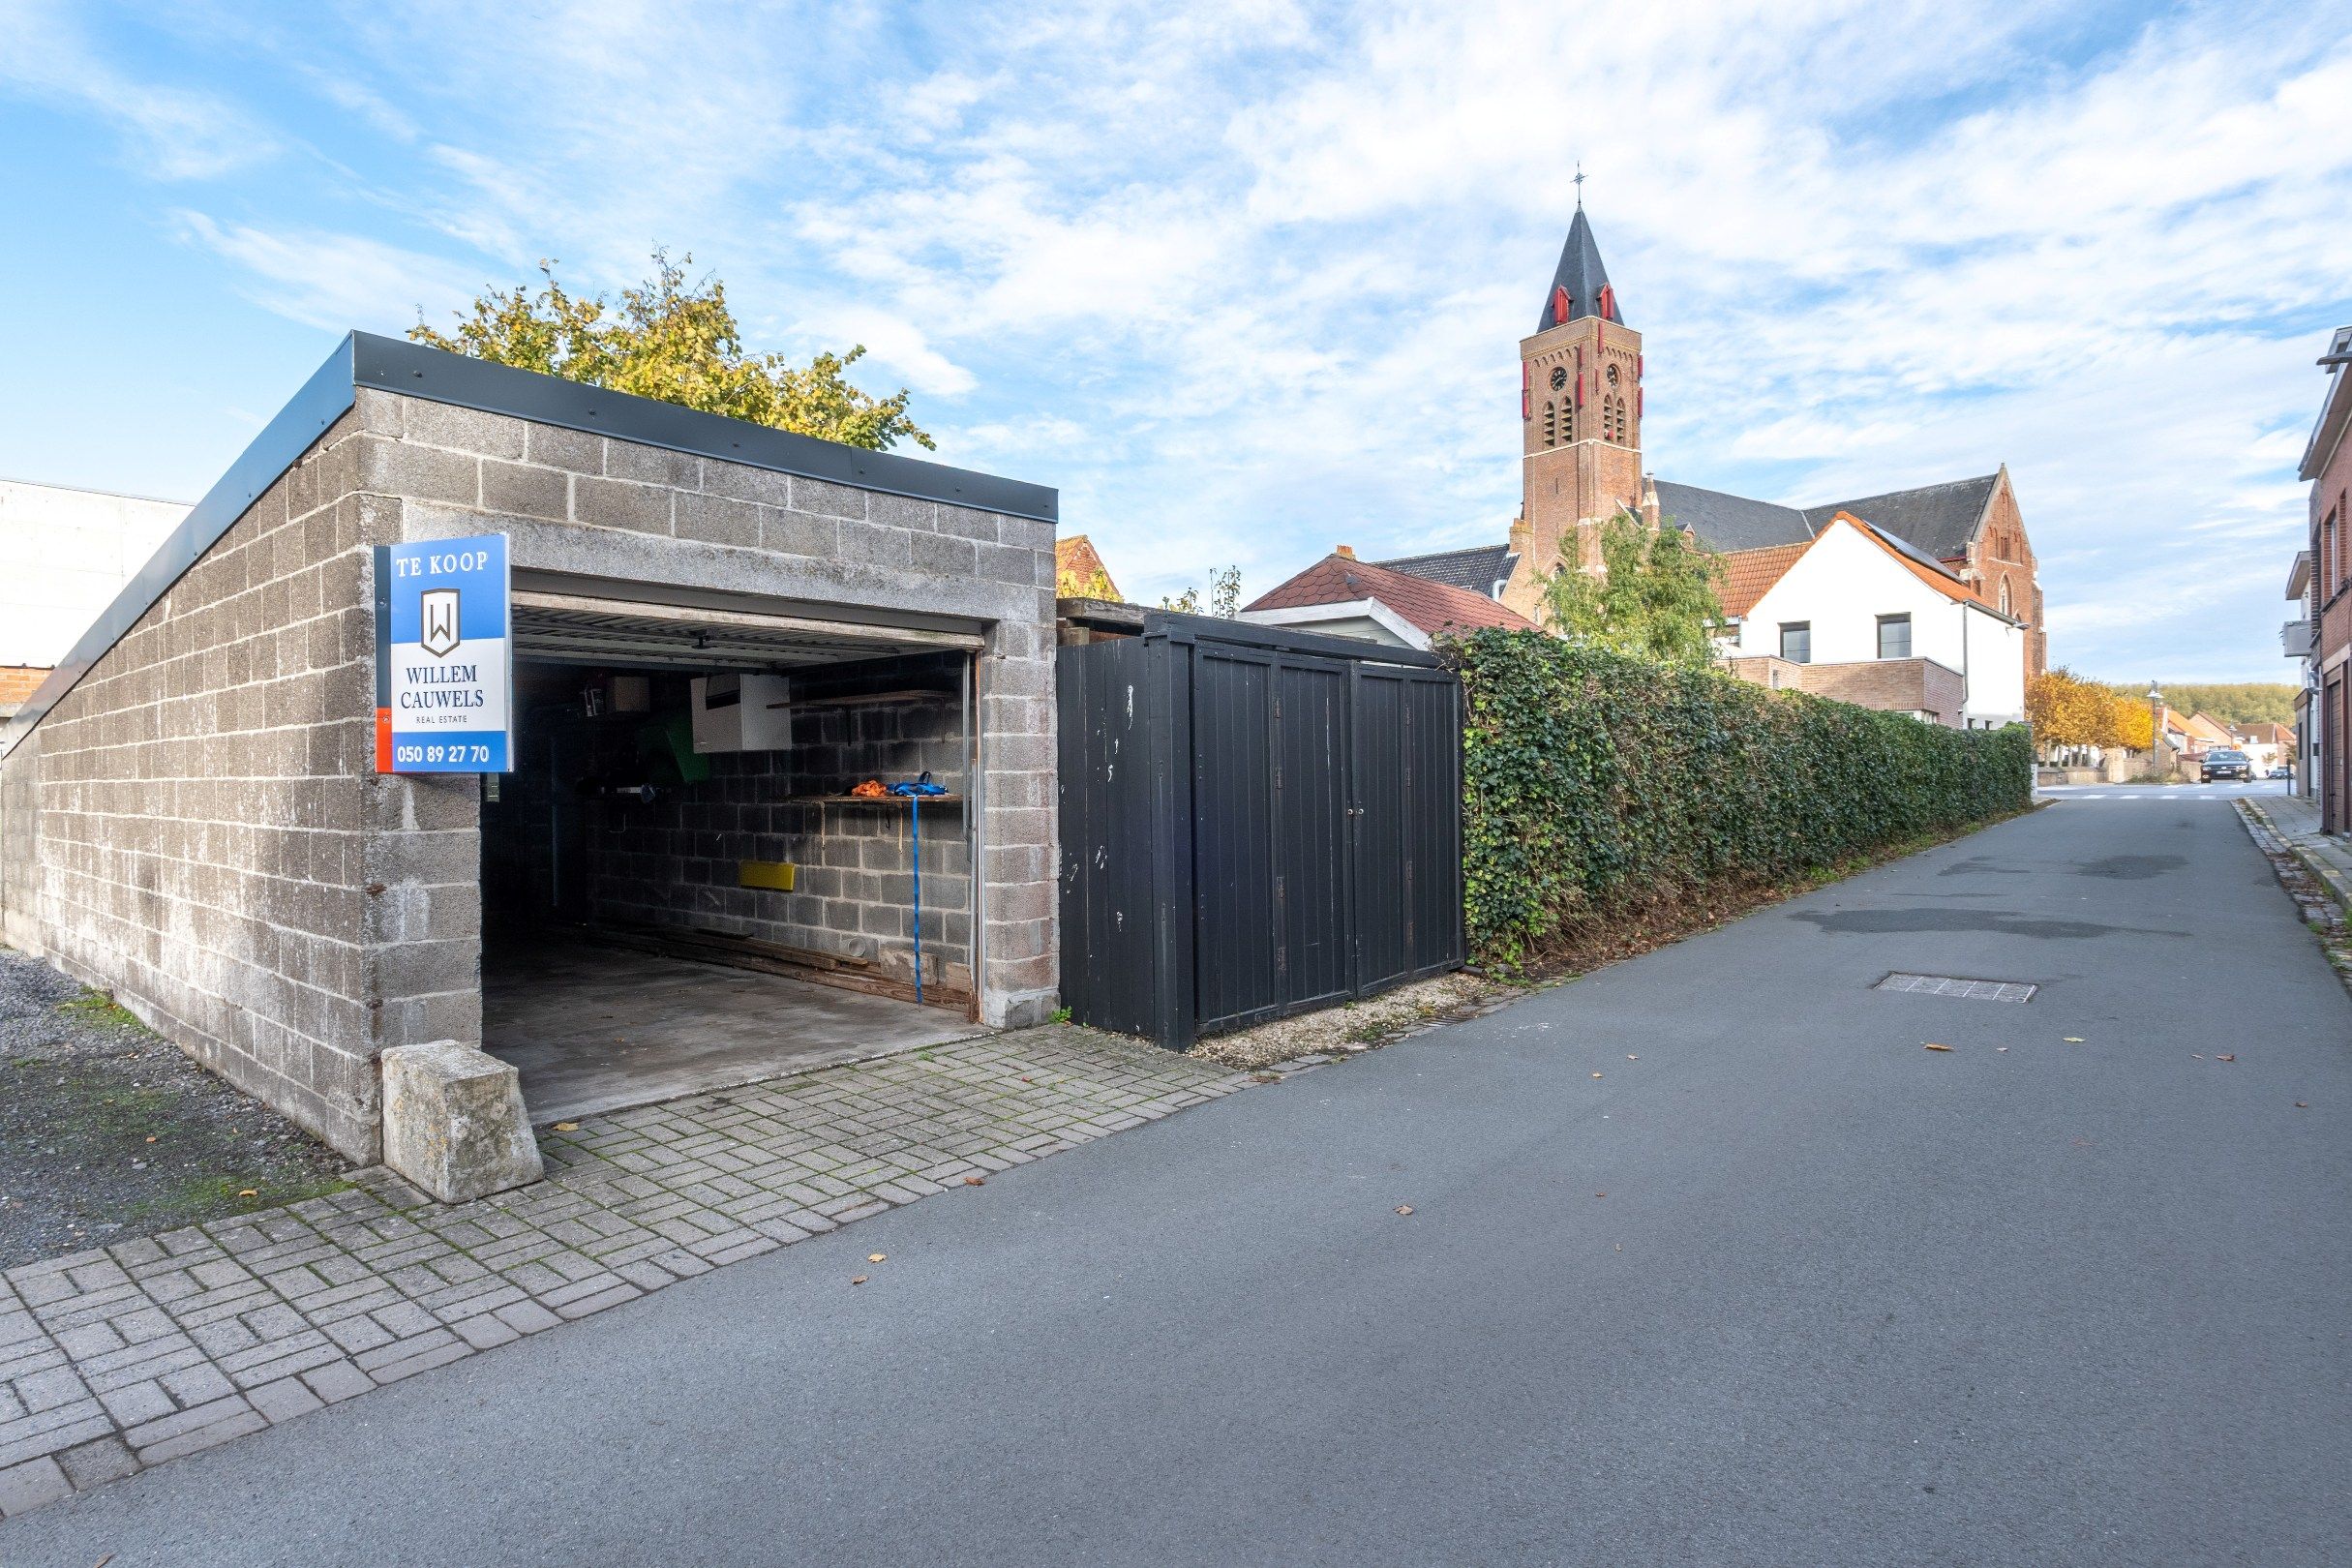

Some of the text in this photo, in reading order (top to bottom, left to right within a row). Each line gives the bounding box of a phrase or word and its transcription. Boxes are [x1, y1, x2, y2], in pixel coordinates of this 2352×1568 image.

[396, 551, 489, 578] TE KOOP
[407, 665, 478, 684] WILLEM
[401, 689, 484, 709] CAUWELS
[438, 715, 467, 724] ESTATE
[397, 745, 490, 763] 050 89 27 70
